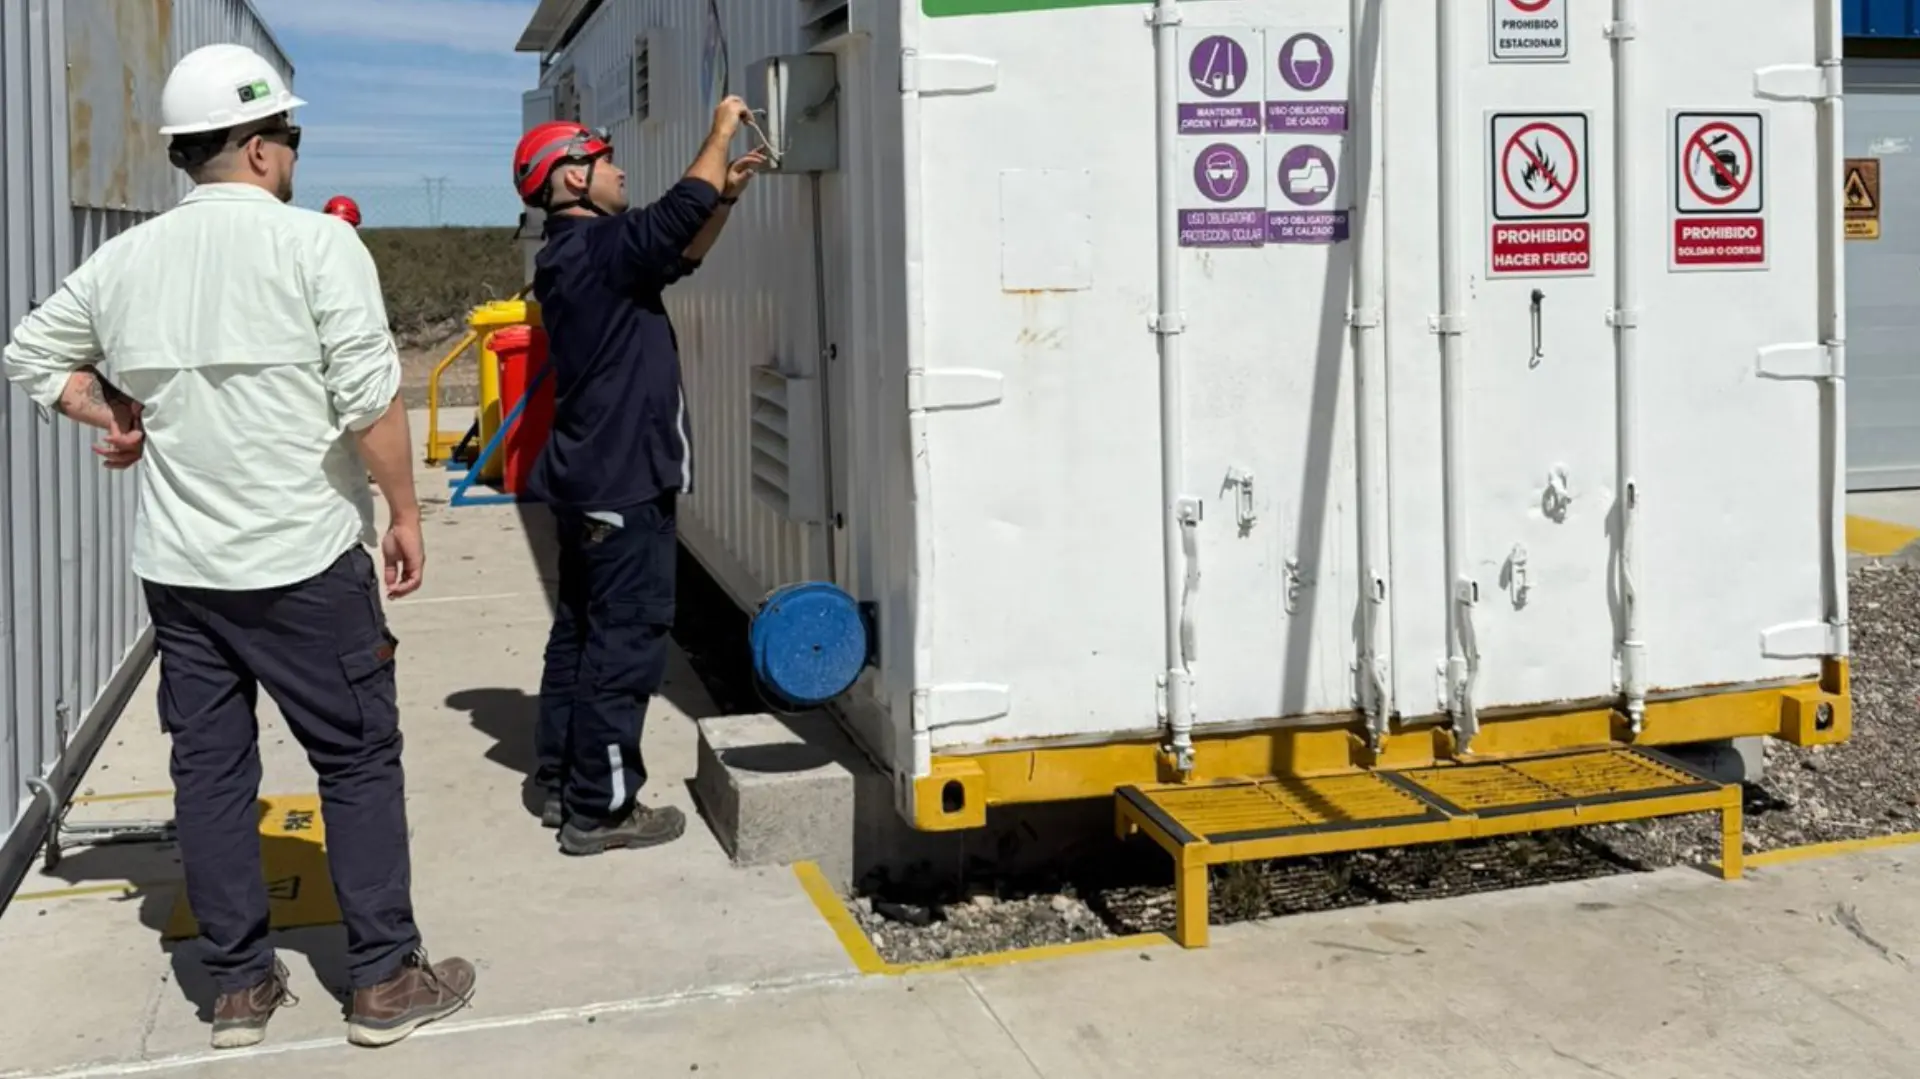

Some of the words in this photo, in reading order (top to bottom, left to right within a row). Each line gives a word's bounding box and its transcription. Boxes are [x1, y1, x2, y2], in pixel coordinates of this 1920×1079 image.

[1502, 19, 1559, 29] PROHIBIDO
[1499, 38, 1562, 49] ESTACIONAR
[1196, 107, 1243, 117] MANTENER
[1269, 106, 1287, 115] USO
[1289, 105, 1345, 115] OBLIGATORIO
[1181, 119, 1211, 129] ORDEN
[1220, 118, 1258, 128] LIMPIEZA
[1285, 117, 1298, 126] DE
[1299, 116, 1329, 127] CASCO
[1270, 216, 1289, 226] USO
[1290, 215, 1346, 225] OBLIGATORIO
[1281, 226, 1294, 236] DE
[1295, 226, 1334, 236] CALZADO
[1497, 228, 1585, 244] PROHIBIDO
[1682, 226, 1757, 240] PROHIBIDO
[1678, 246, 1715, 256] SOLDAR
[1716, 246, 1724, 255] O
[1726, 245, 1762, 255] CORTAR
[1494, 253, 1540, 266] HACER
[1542, 251, 1588, 265] FUEGO
